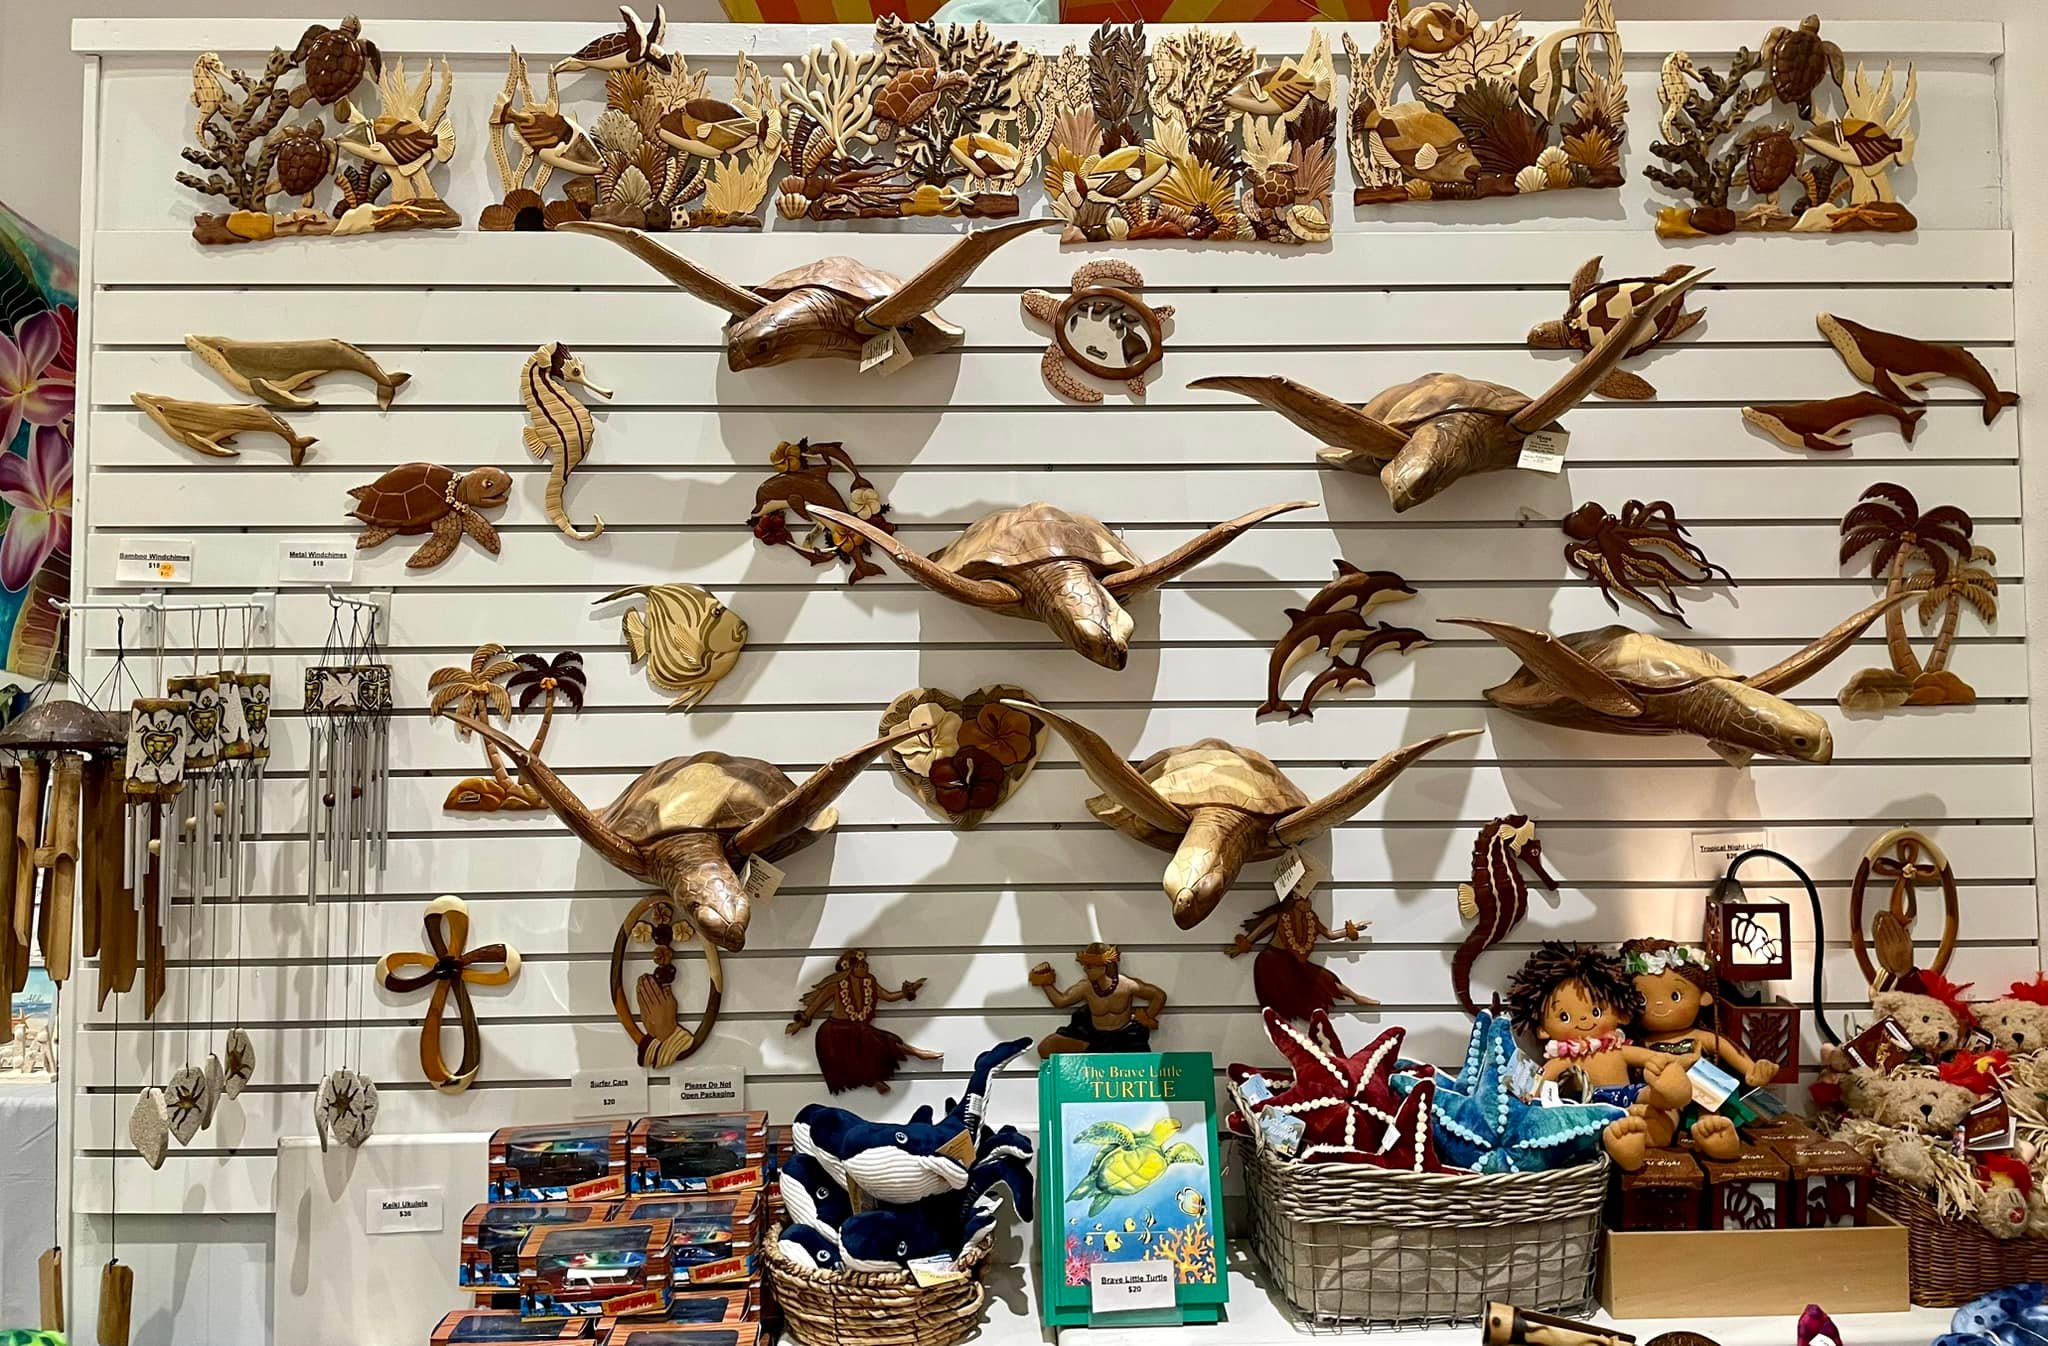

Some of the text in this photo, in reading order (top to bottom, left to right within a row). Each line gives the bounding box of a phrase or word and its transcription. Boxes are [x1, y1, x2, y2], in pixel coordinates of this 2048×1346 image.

[119, 552, 190, 562] Bamboo Windchimes
[289, 551, 347, 559] Metal Windchimes
[1700, 844, 1726, 853] Tropical
[1727, 844, 1745, 852] Night
[1082, 1064, 1183, 1079] The Brave Little
[590, 1079, 629, 1089] Surfer Cars
[684, 1080, 732, 1090] Please Do Not
[1090, 1080, 1177, 1099] TURTLE
[680, 1090, 736, 1100] Open Packaging
[382, 1199, 429, 1210] Keiki Ukulele
[1101, 1273, 1168, 1285] Brave Little Turtle
[1127, 1285, 1142, 1294] $20
